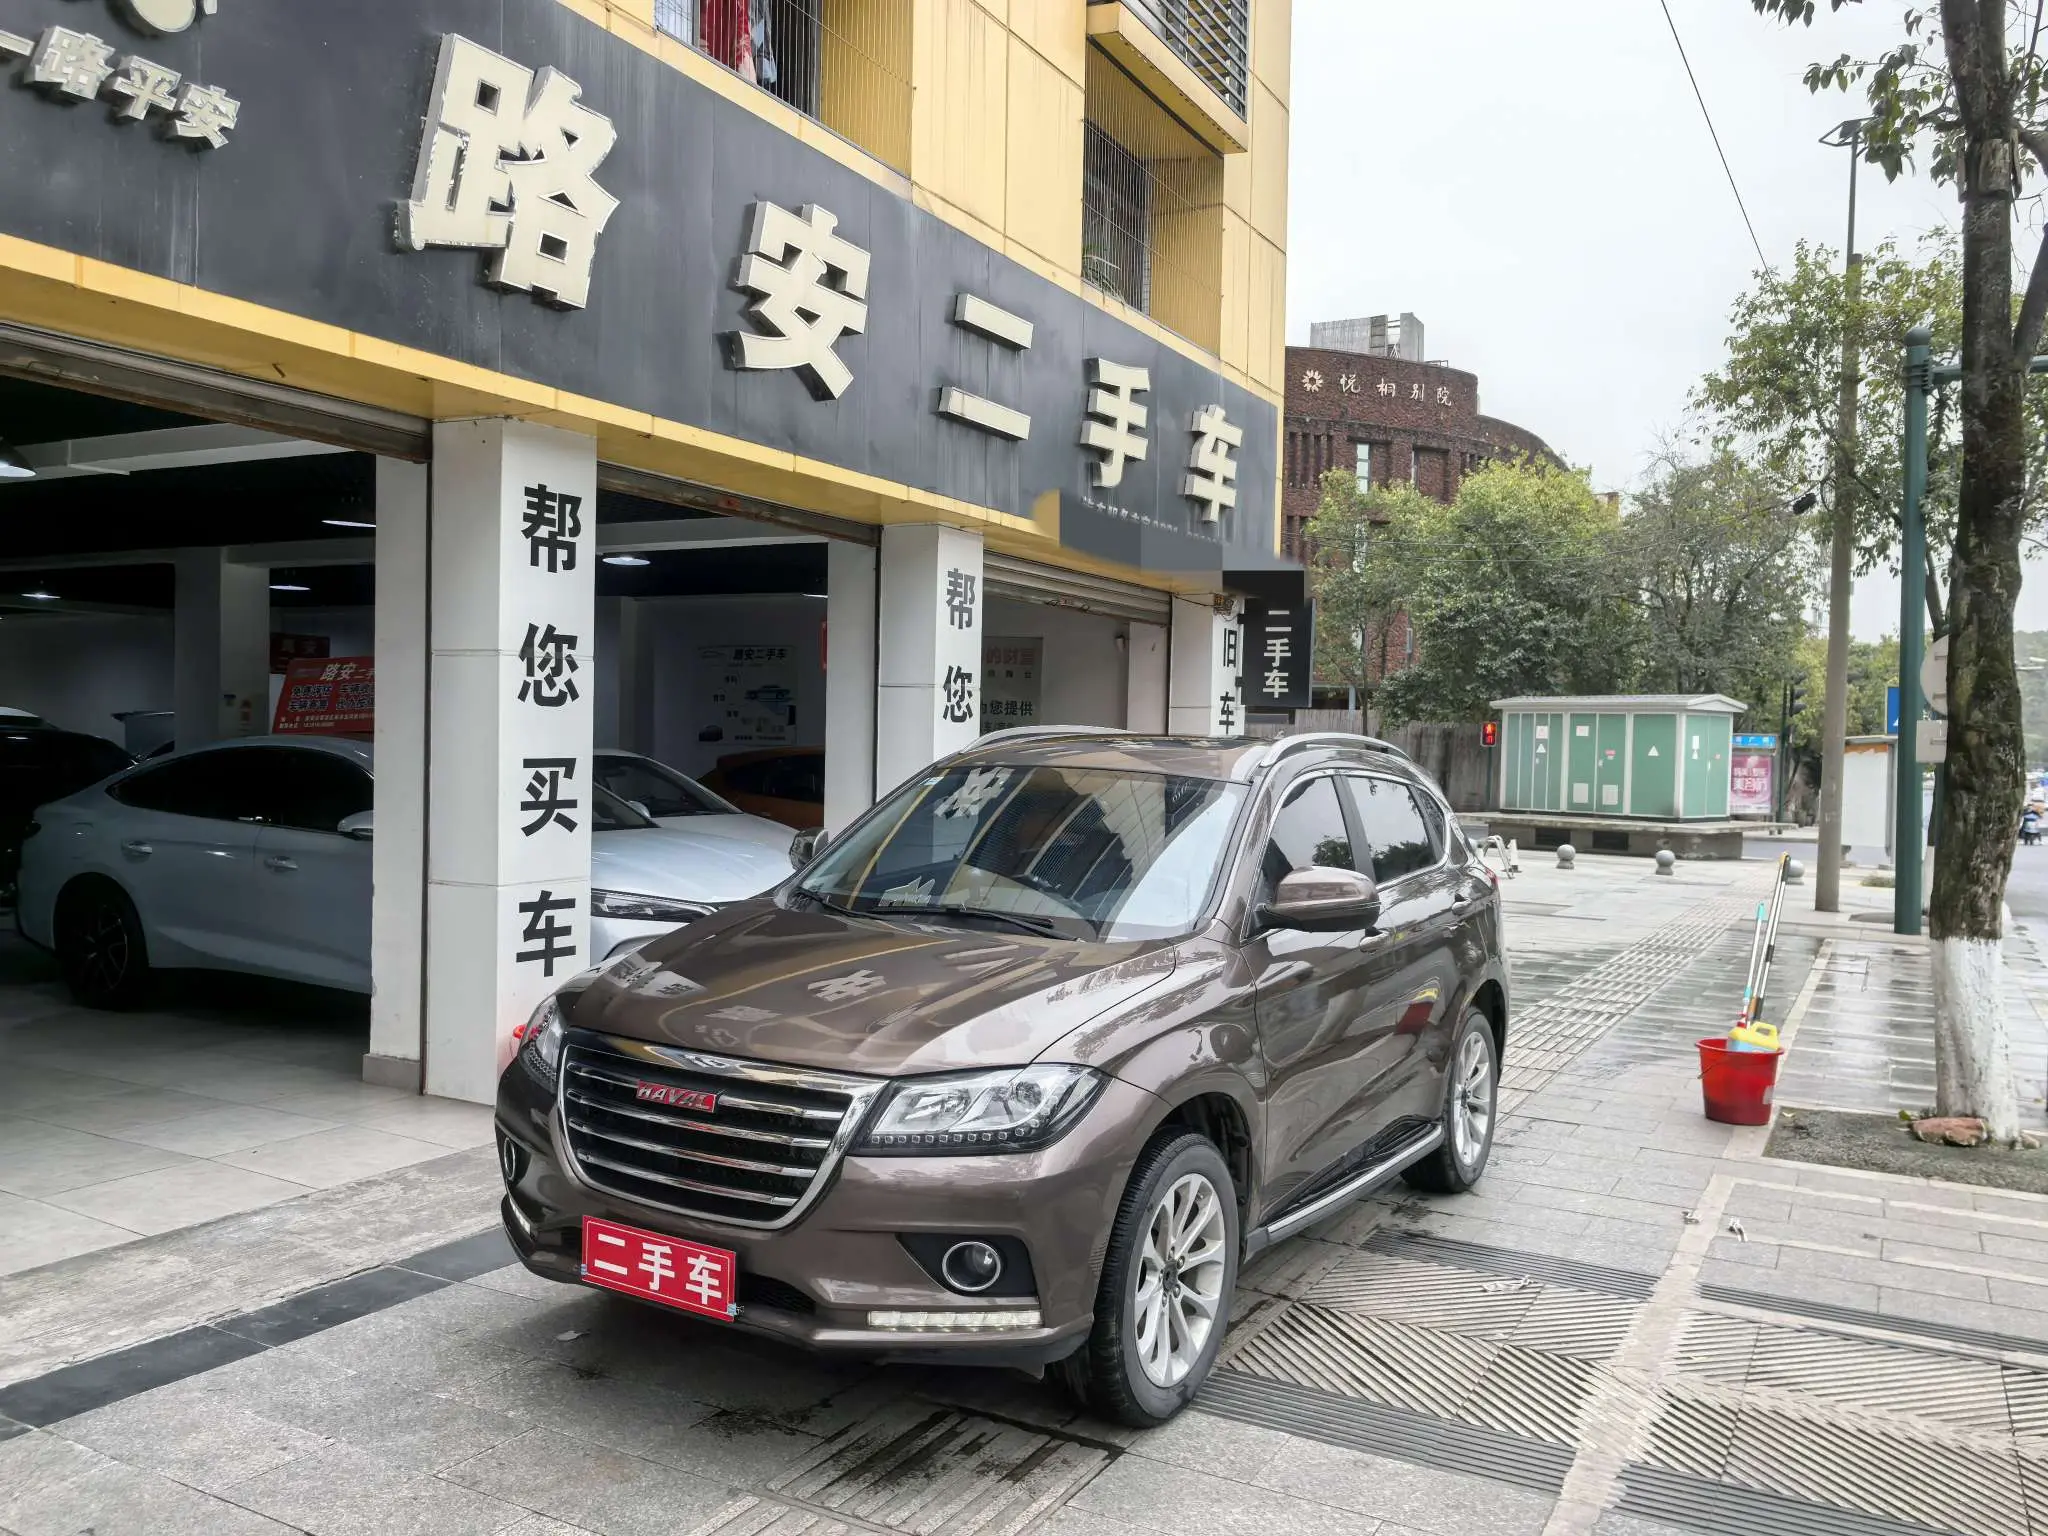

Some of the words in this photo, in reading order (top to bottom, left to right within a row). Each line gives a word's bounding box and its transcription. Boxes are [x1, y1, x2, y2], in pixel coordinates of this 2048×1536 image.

[400, 33, 1243, 522] 路安二手车
[1339, 373, 1452, 406] 悦桐别院
[943, 568, 976, 722] 帮您
[1219, 628, 1238, 735] 旧车
[1263, 610, 1292, 699] 二手车
[515, 484, 583, 977] 帮您买车
[593, 1233, 722, 1305] 二手车
